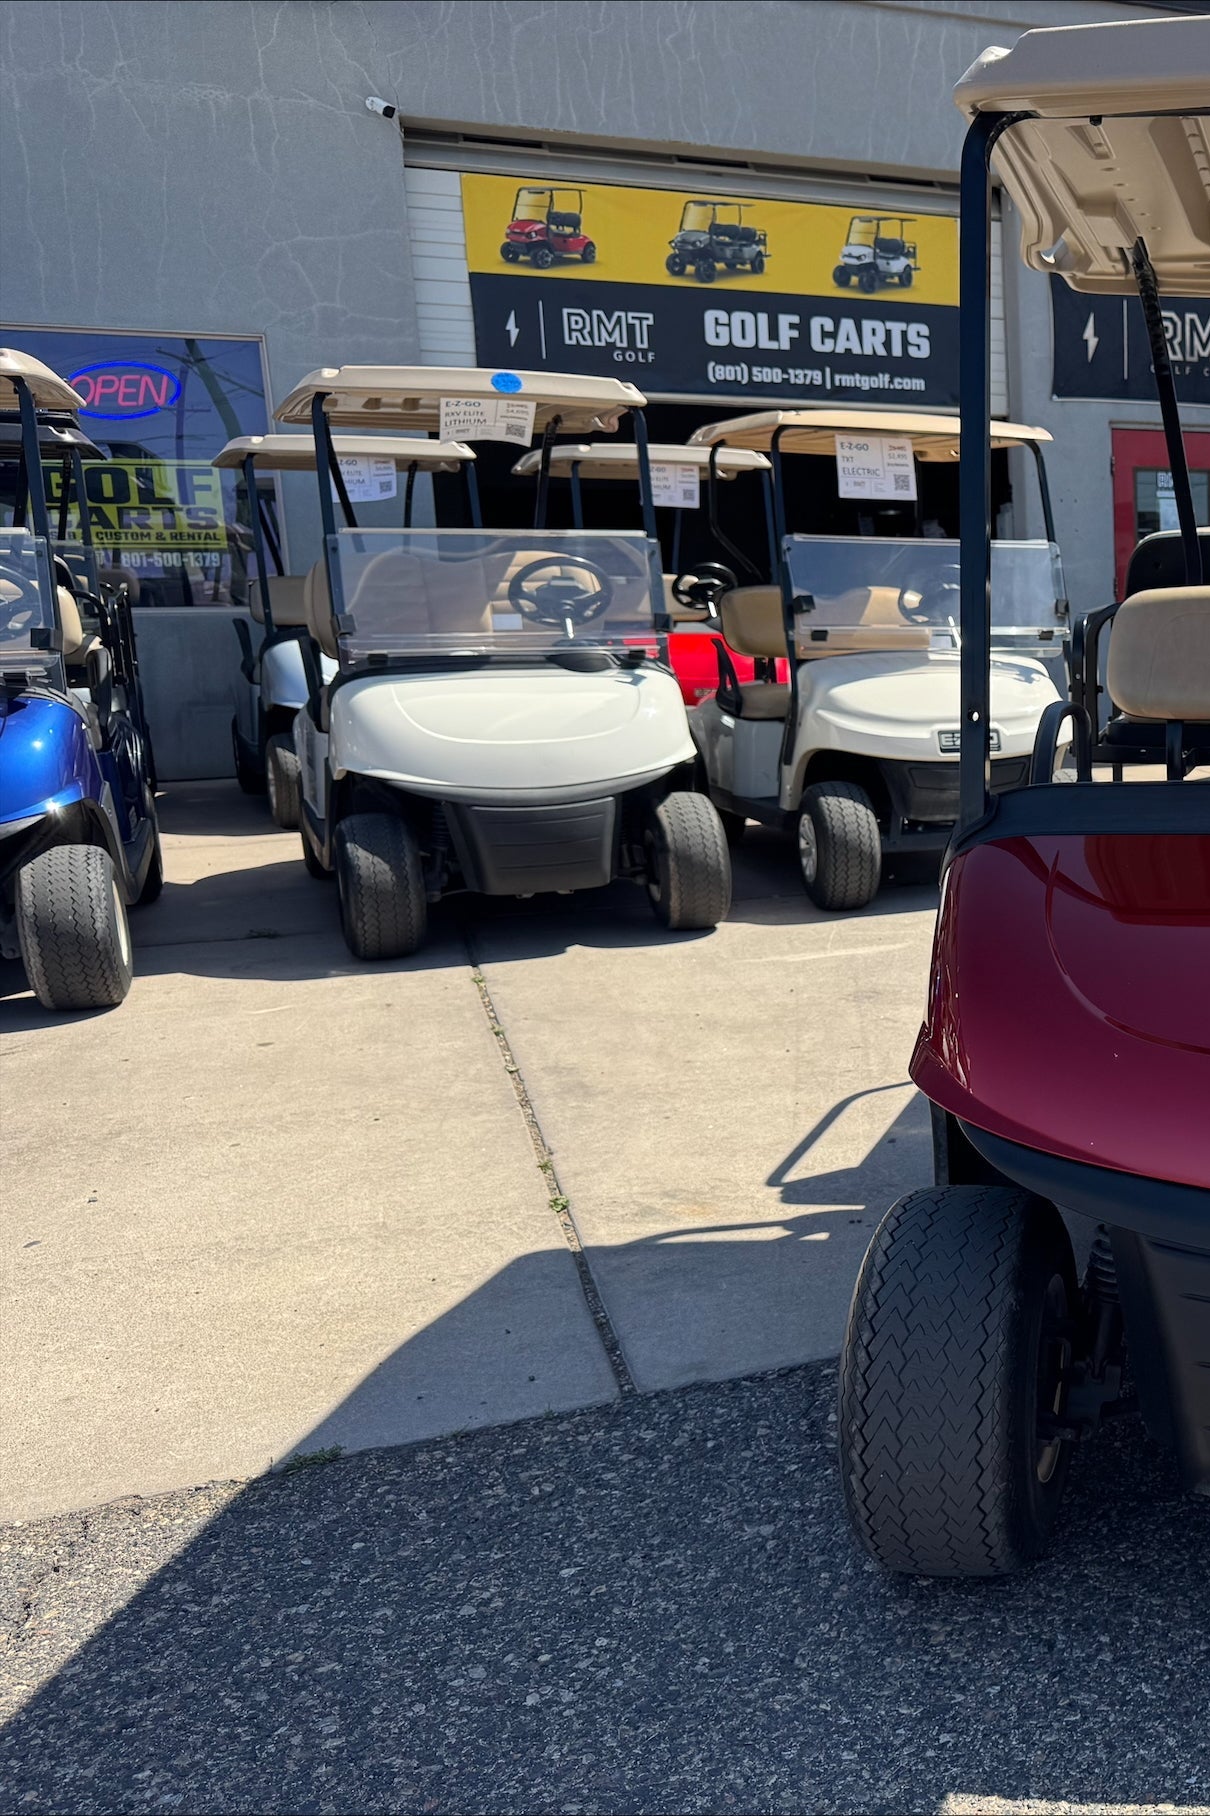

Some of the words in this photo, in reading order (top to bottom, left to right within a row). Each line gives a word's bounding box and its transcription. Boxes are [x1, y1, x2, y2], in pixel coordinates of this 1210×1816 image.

[562, 307, 654, 350] RMT
[704, 309, 800, 353] GOLF
[810, 314, 931, 360] CARTS
[613, 349, 656, 364] GOLF
[707, 361, 750, 386] (801)
[751, 365, 823, 388] 500-1379
[833, 369, 926, 393] rmtgolf.com
[71, 375, 168, 407] OPEN
[840, 442, 869, 451] E-Z-GO
[842, 466, 881, 477] ELECTRIC
[95, 530, 147, 542] CUSTOM
[155, 530, 167, 541] &
[170, 529, 220, 542] RENTAL
[120, 551, 221, 568] 801-500-1379
